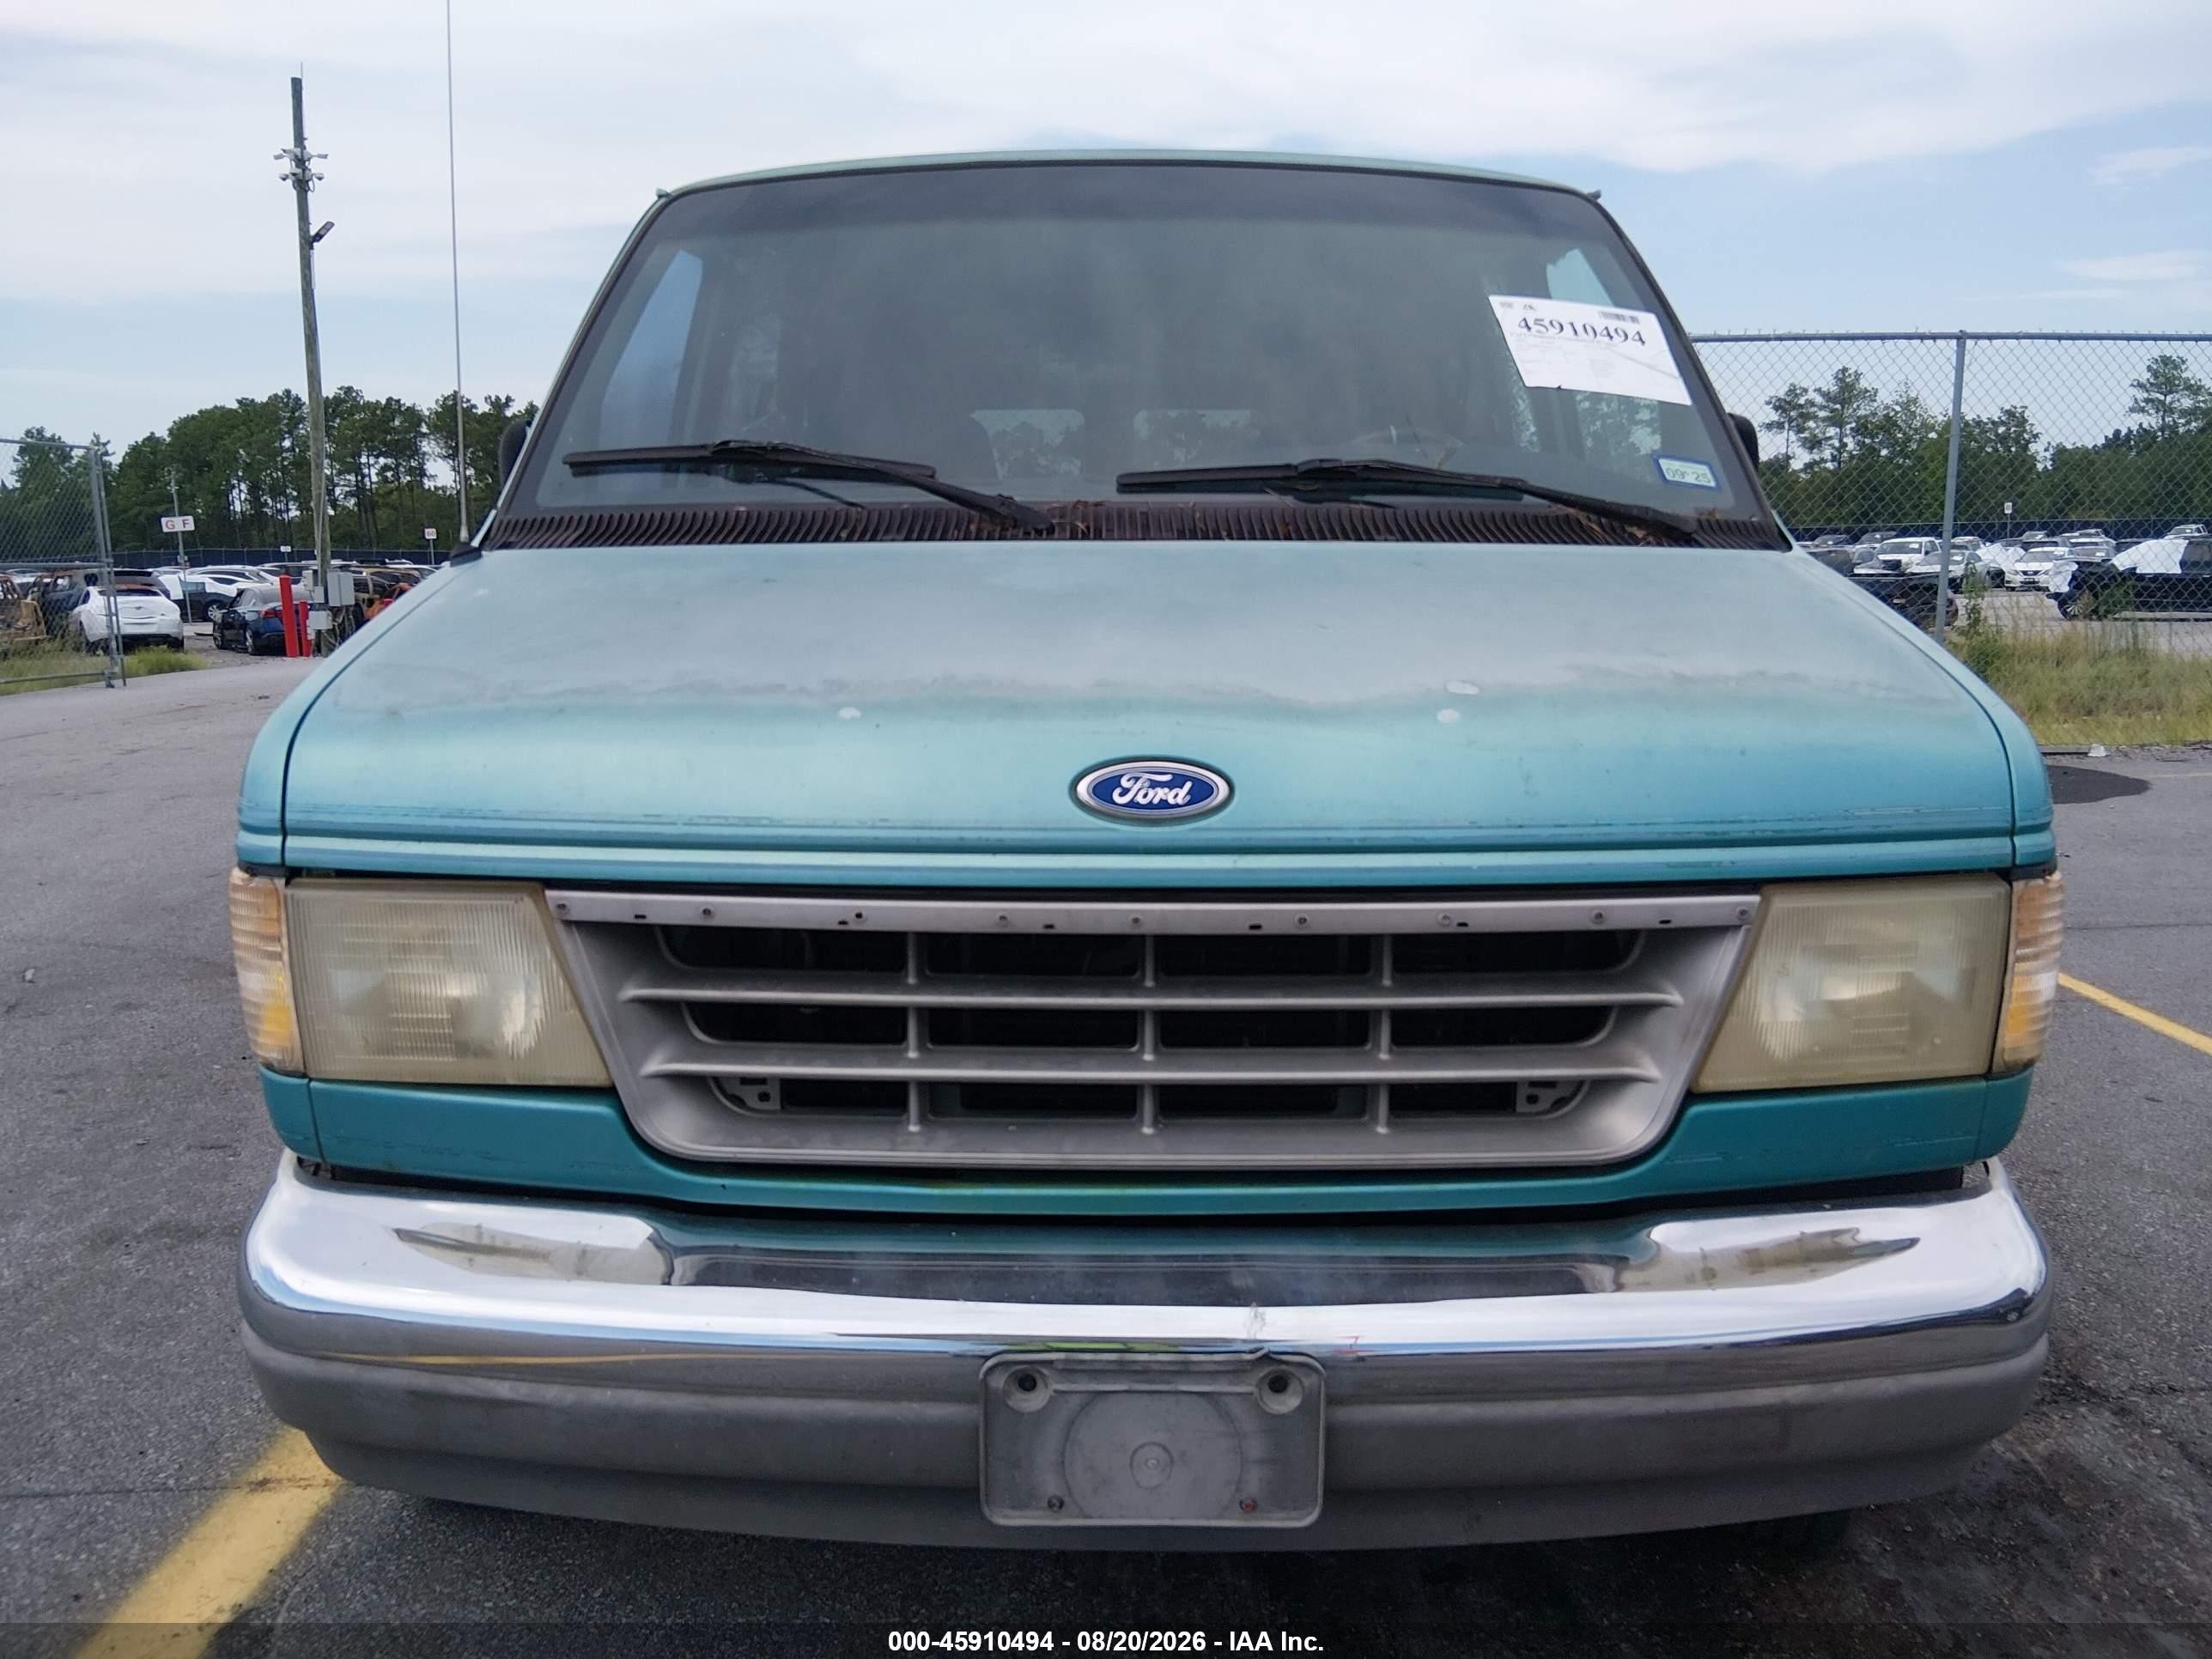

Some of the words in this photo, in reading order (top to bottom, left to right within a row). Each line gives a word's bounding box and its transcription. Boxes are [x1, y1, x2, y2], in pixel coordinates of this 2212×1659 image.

[1517, 316, 1646, 346] 45910494
[165, 520, 176, 530] G
[182, 519, 190, 529] F
[1112, 773, 1194, 805] Ford
